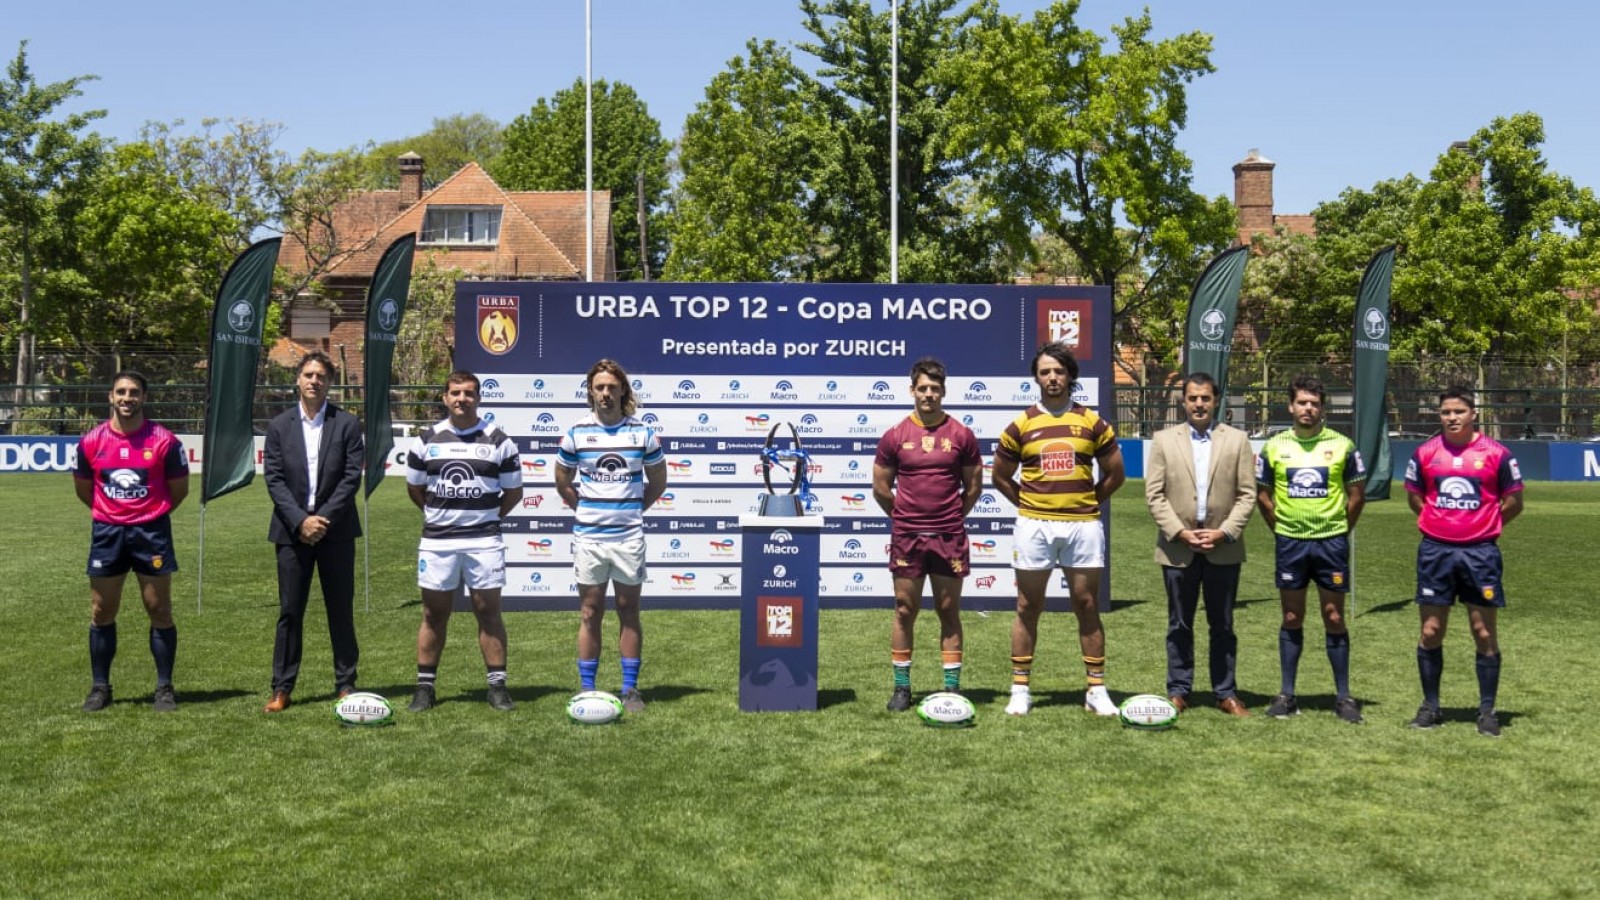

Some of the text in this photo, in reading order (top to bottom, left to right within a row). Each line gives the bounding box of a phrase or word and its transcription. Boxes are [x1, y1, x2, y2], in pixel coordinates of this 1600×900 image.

[482, 297, 514, 306] URBA
[575, 296, 661, 319] URBA
[669, 296, 730, 319] TOP
[739, 296, 767, 318] 12
[797, 297, 872, 323] Copa
[882, 298, 992, 320] MACRO
[1049, 310, 1079, 321] TOP
[216, 332, 233, 342] SAN
[1049, 322, 1079, 345] 12
[662, 338, 906, 358] Presentada por ZURICH
[1190, 341, 1205, 351] SAN
[1356, 339, 1369, 349] SAN
[525, 391, 553, 399] ZURICH
[672, 391, 701, 400] Macro
[770, 392, 798, 400] Macro
[867, 392, 895, 401] Macro
[964, 393, 992, 401] Macro
[531, 424, 559, 432] Macro
[796, 425, 823, 433] Macro
[0, 442, 79, 471] DICU
[1042, 452, 1074, 460] BURGER
[1043, 459, 1074, 471] KING
[590, 473, 633, 483] Macro
[103, 486, 148, 499] Macro
[436, 484, 482, 498] Macro
[1288, 487, 1326, 497] Macro
[1435, 496, 1481, 510] Macro
[973, 505, 1001, 513] Macro
[763, 544, 799, 554] Macro
[839, 551, 867, 559] Macro
[763, 580, 797, 588] ZURICH
[767, 605, 792, 616] TOP
[767, 616, 792, 635] 12
[341, 703, 387, 715] GILBERT
[933, 705, 962, 715] Macro
[1126, 706, 1171, 716] GILBERT
